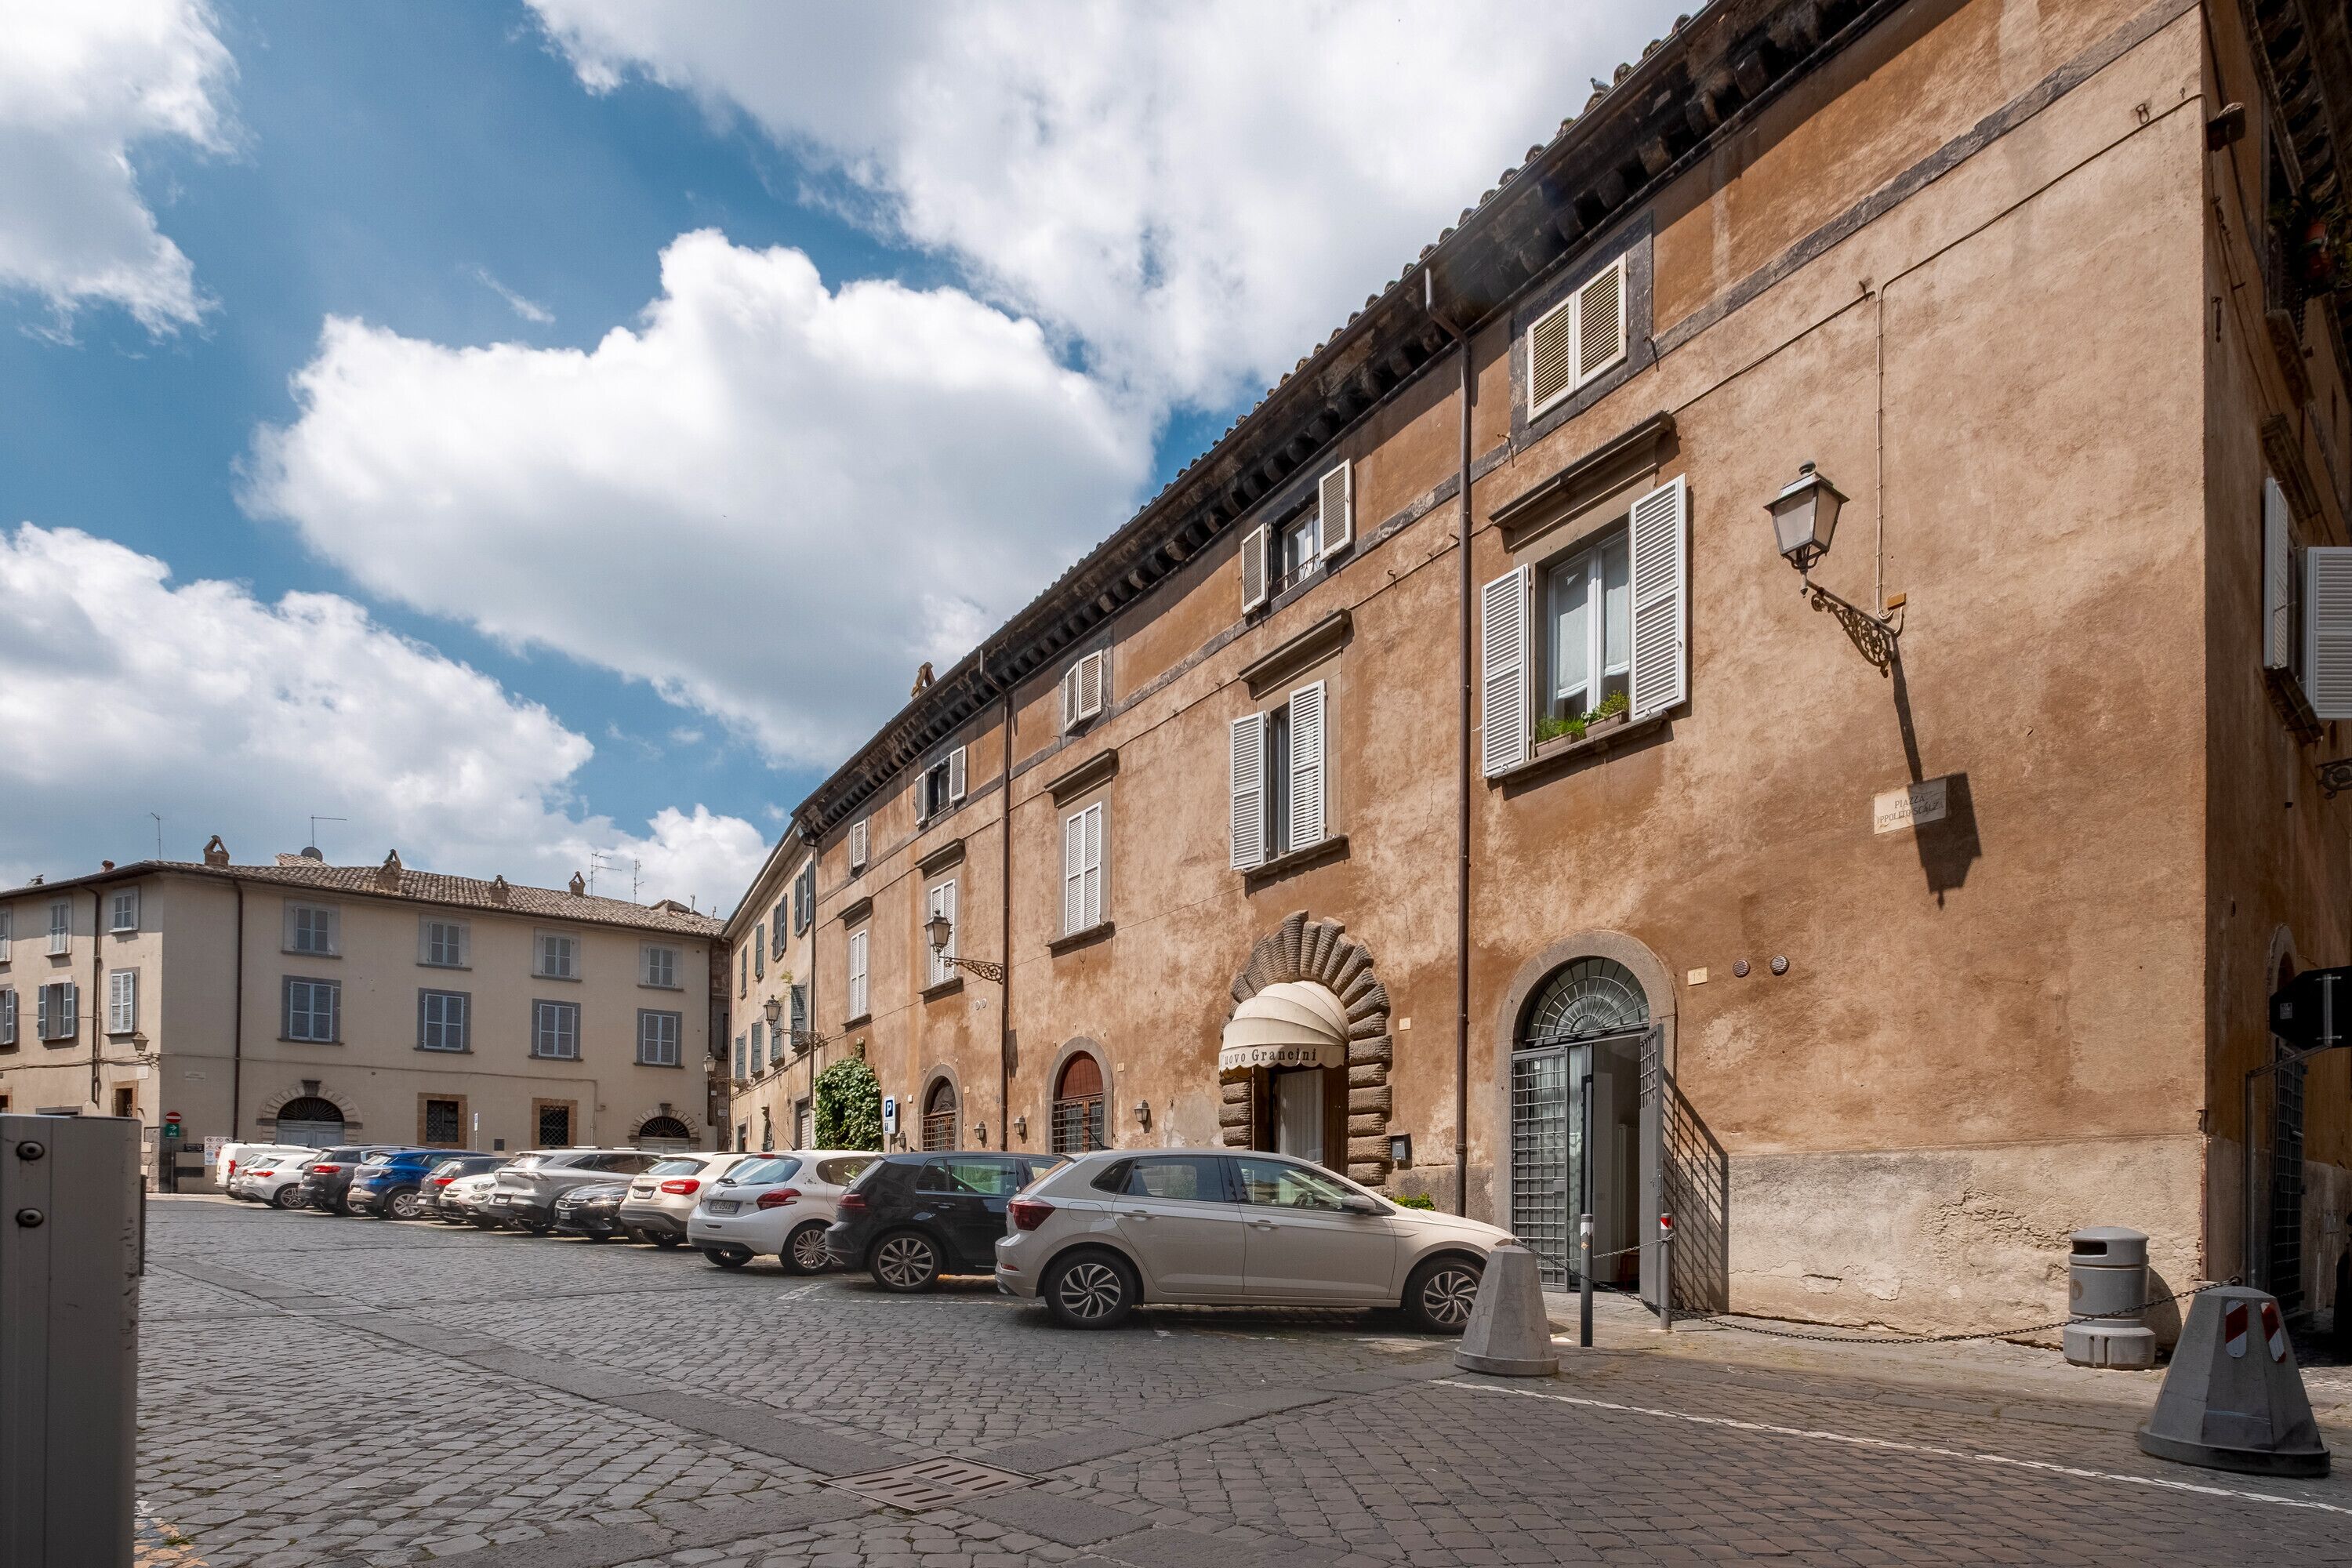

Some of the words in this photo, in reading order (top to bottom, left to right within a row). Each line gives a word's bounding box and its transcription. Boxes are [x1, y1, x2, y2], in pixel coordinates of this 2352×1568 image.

[1894, 795, 1925, 809] PIAZZA
[1877, 809, 1911, 824] IPPOLITO
[1251, 1048, 1317, 1062] Grancini
[887, 1102, 892, 1116] P
